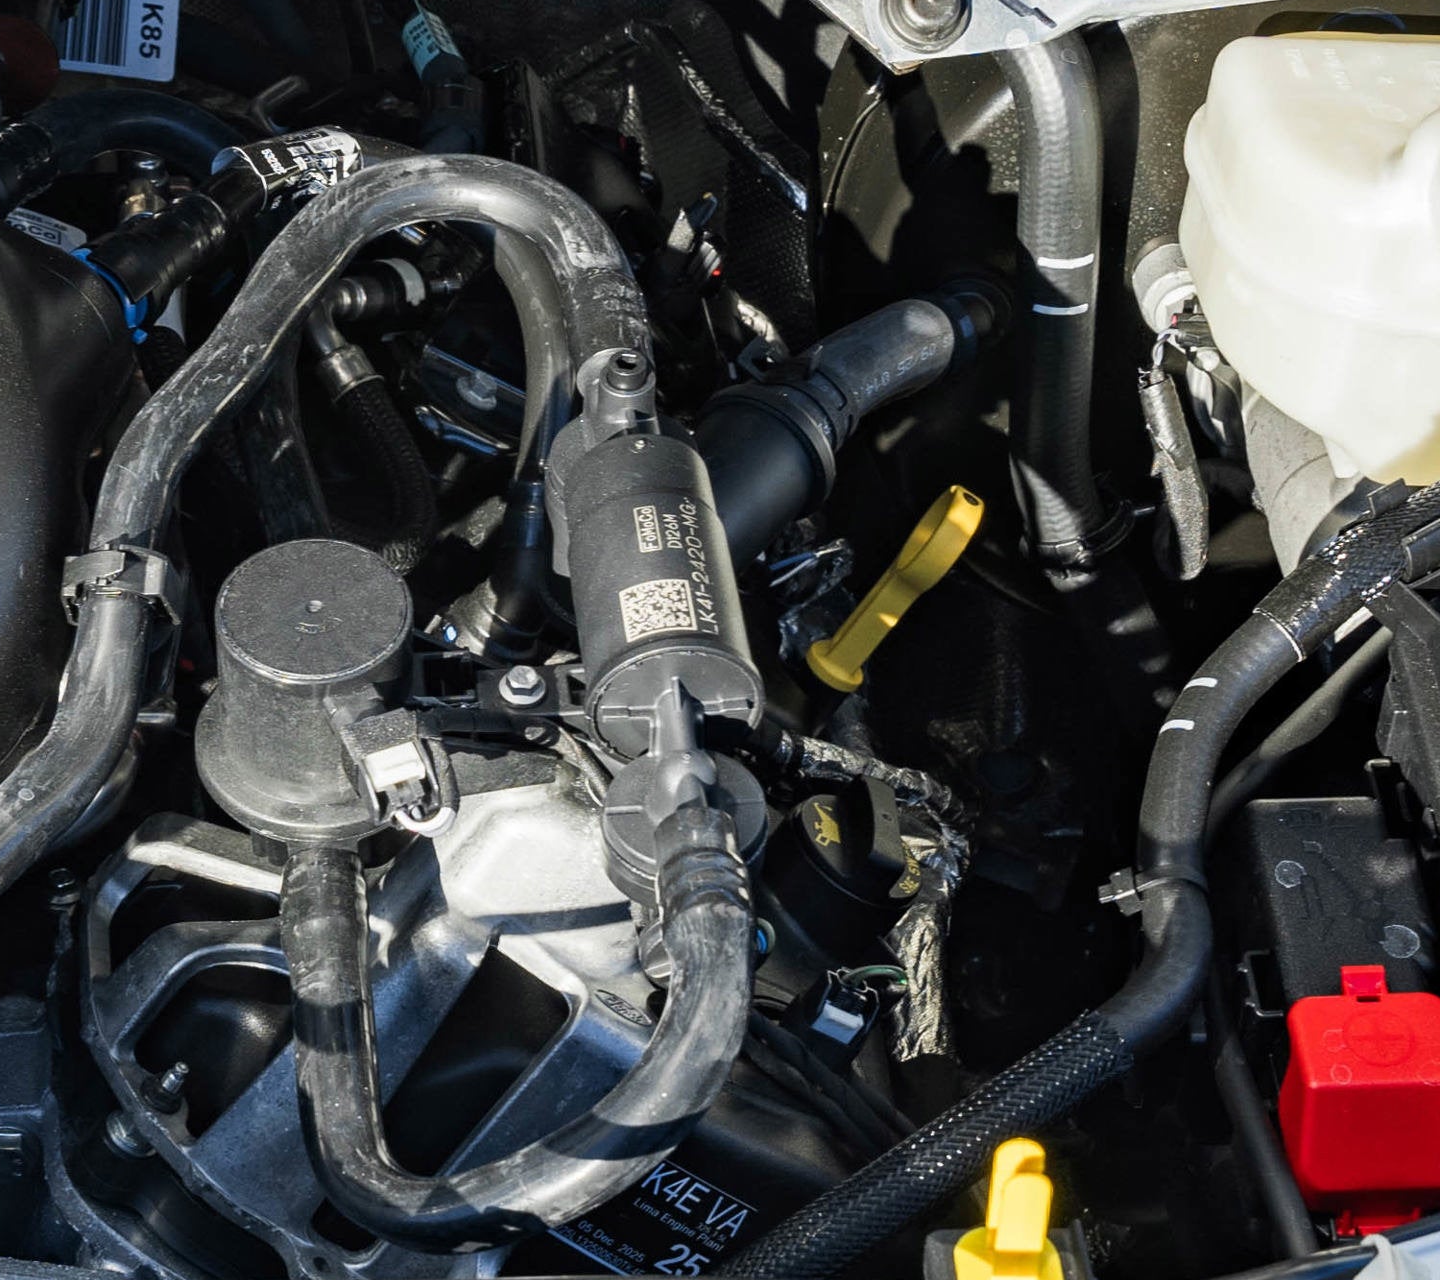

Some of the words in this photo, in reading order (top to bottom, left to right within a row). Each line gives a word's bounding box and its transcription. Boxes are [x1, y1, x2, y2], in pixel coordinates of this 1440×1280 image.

[139, 2, 164, 60] K85
[641, 507, 659, 551] FoMoCo
[632, 1197, 660, 1220] Lima
[659, 1210, 698, 1240] Engine
[641, 1161, 712, 1214] K4E
[707, 1200, 752, 1240] VA
[616, 1239, 646, 1264] 2025
[653, 1241, 711, 1277] 25
